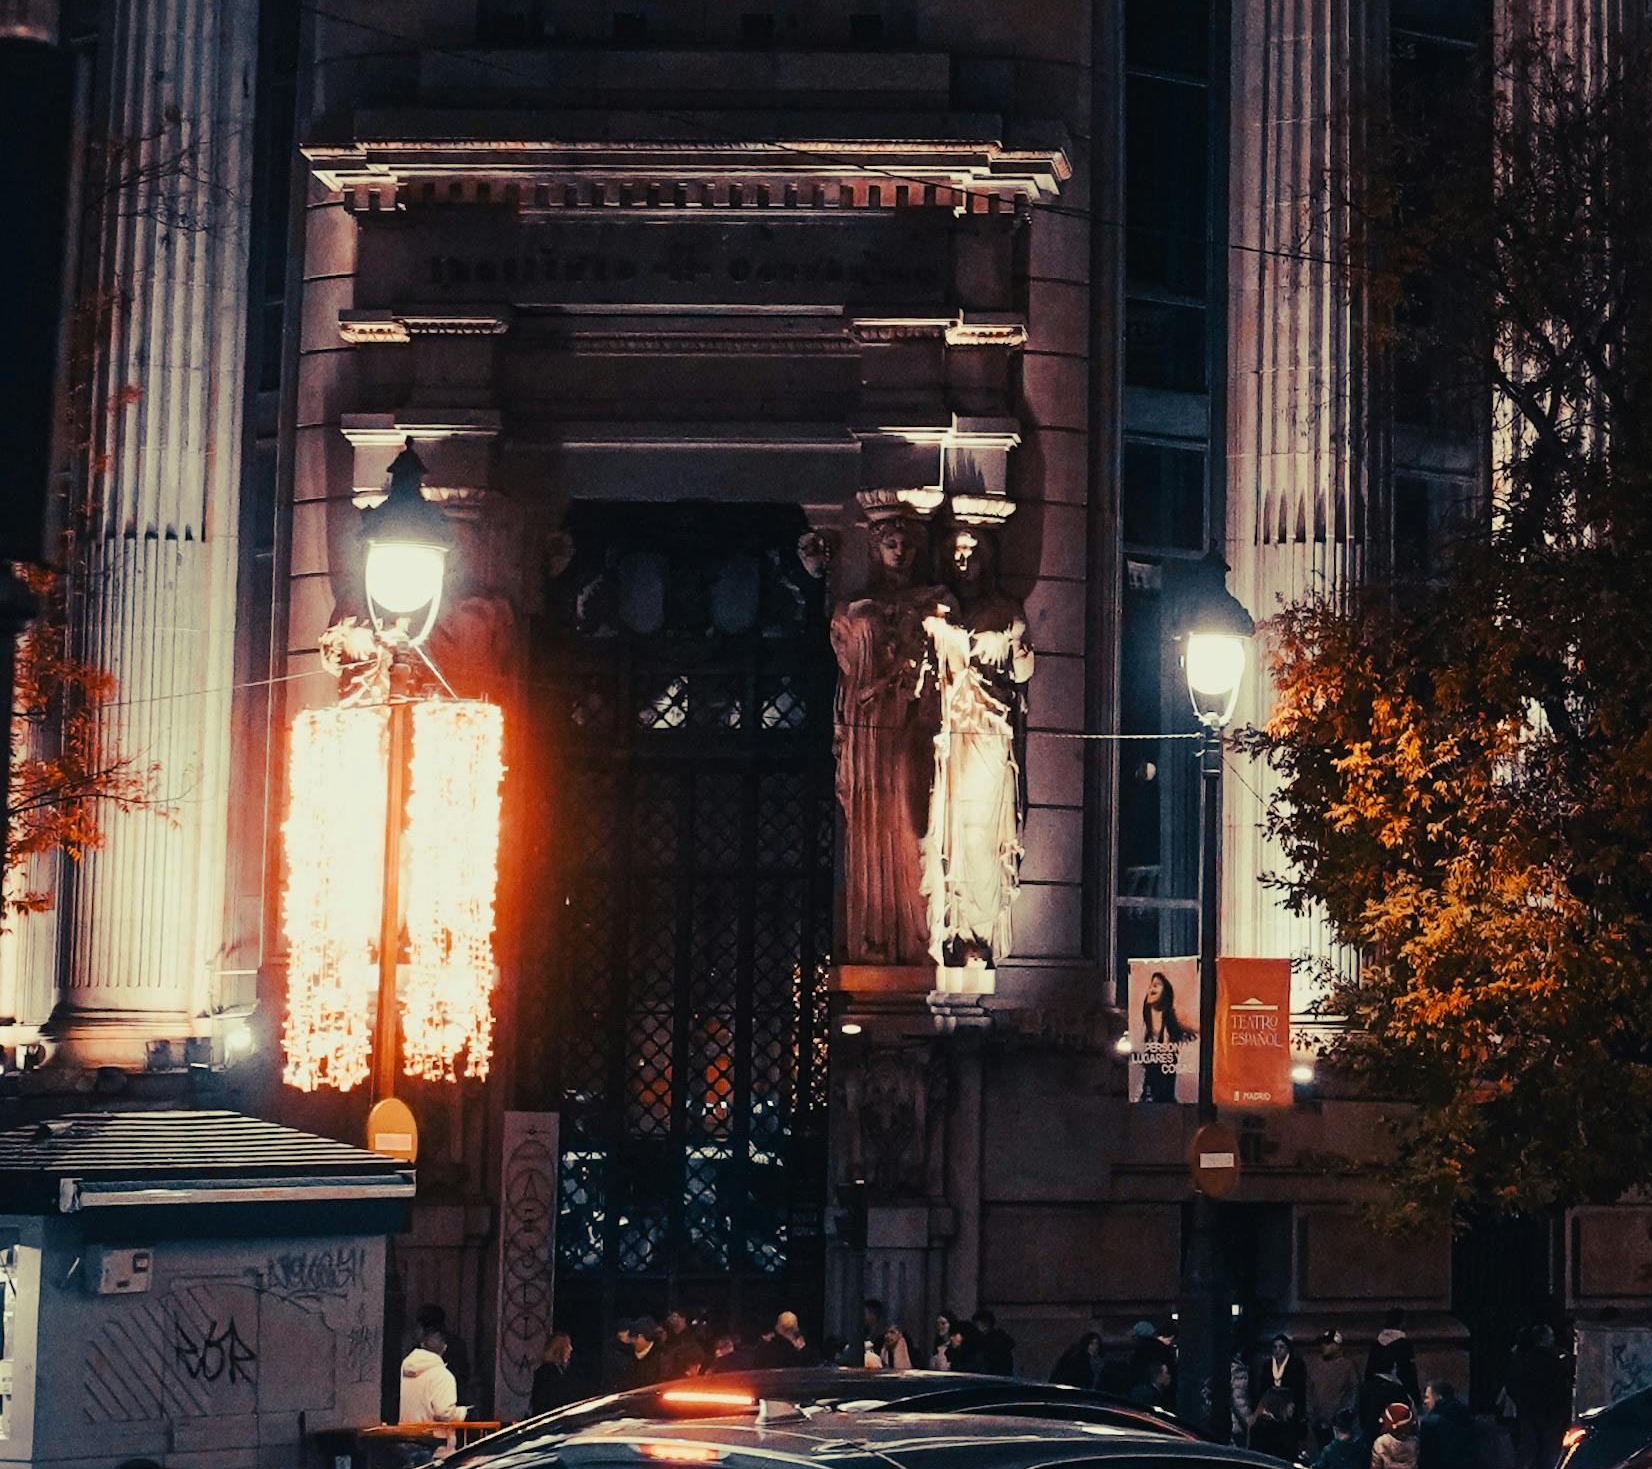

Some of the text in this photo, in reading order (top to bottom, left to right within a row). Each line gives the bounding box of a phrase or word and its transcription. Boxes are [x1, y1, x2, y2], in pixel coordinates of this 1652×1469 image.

[1230, 1014, 1278, 1032] TEATRO
[1230, 1029, 1283, 1047] ESPAÑOL
[1242, 1091, 1272, 1102] MADRID
